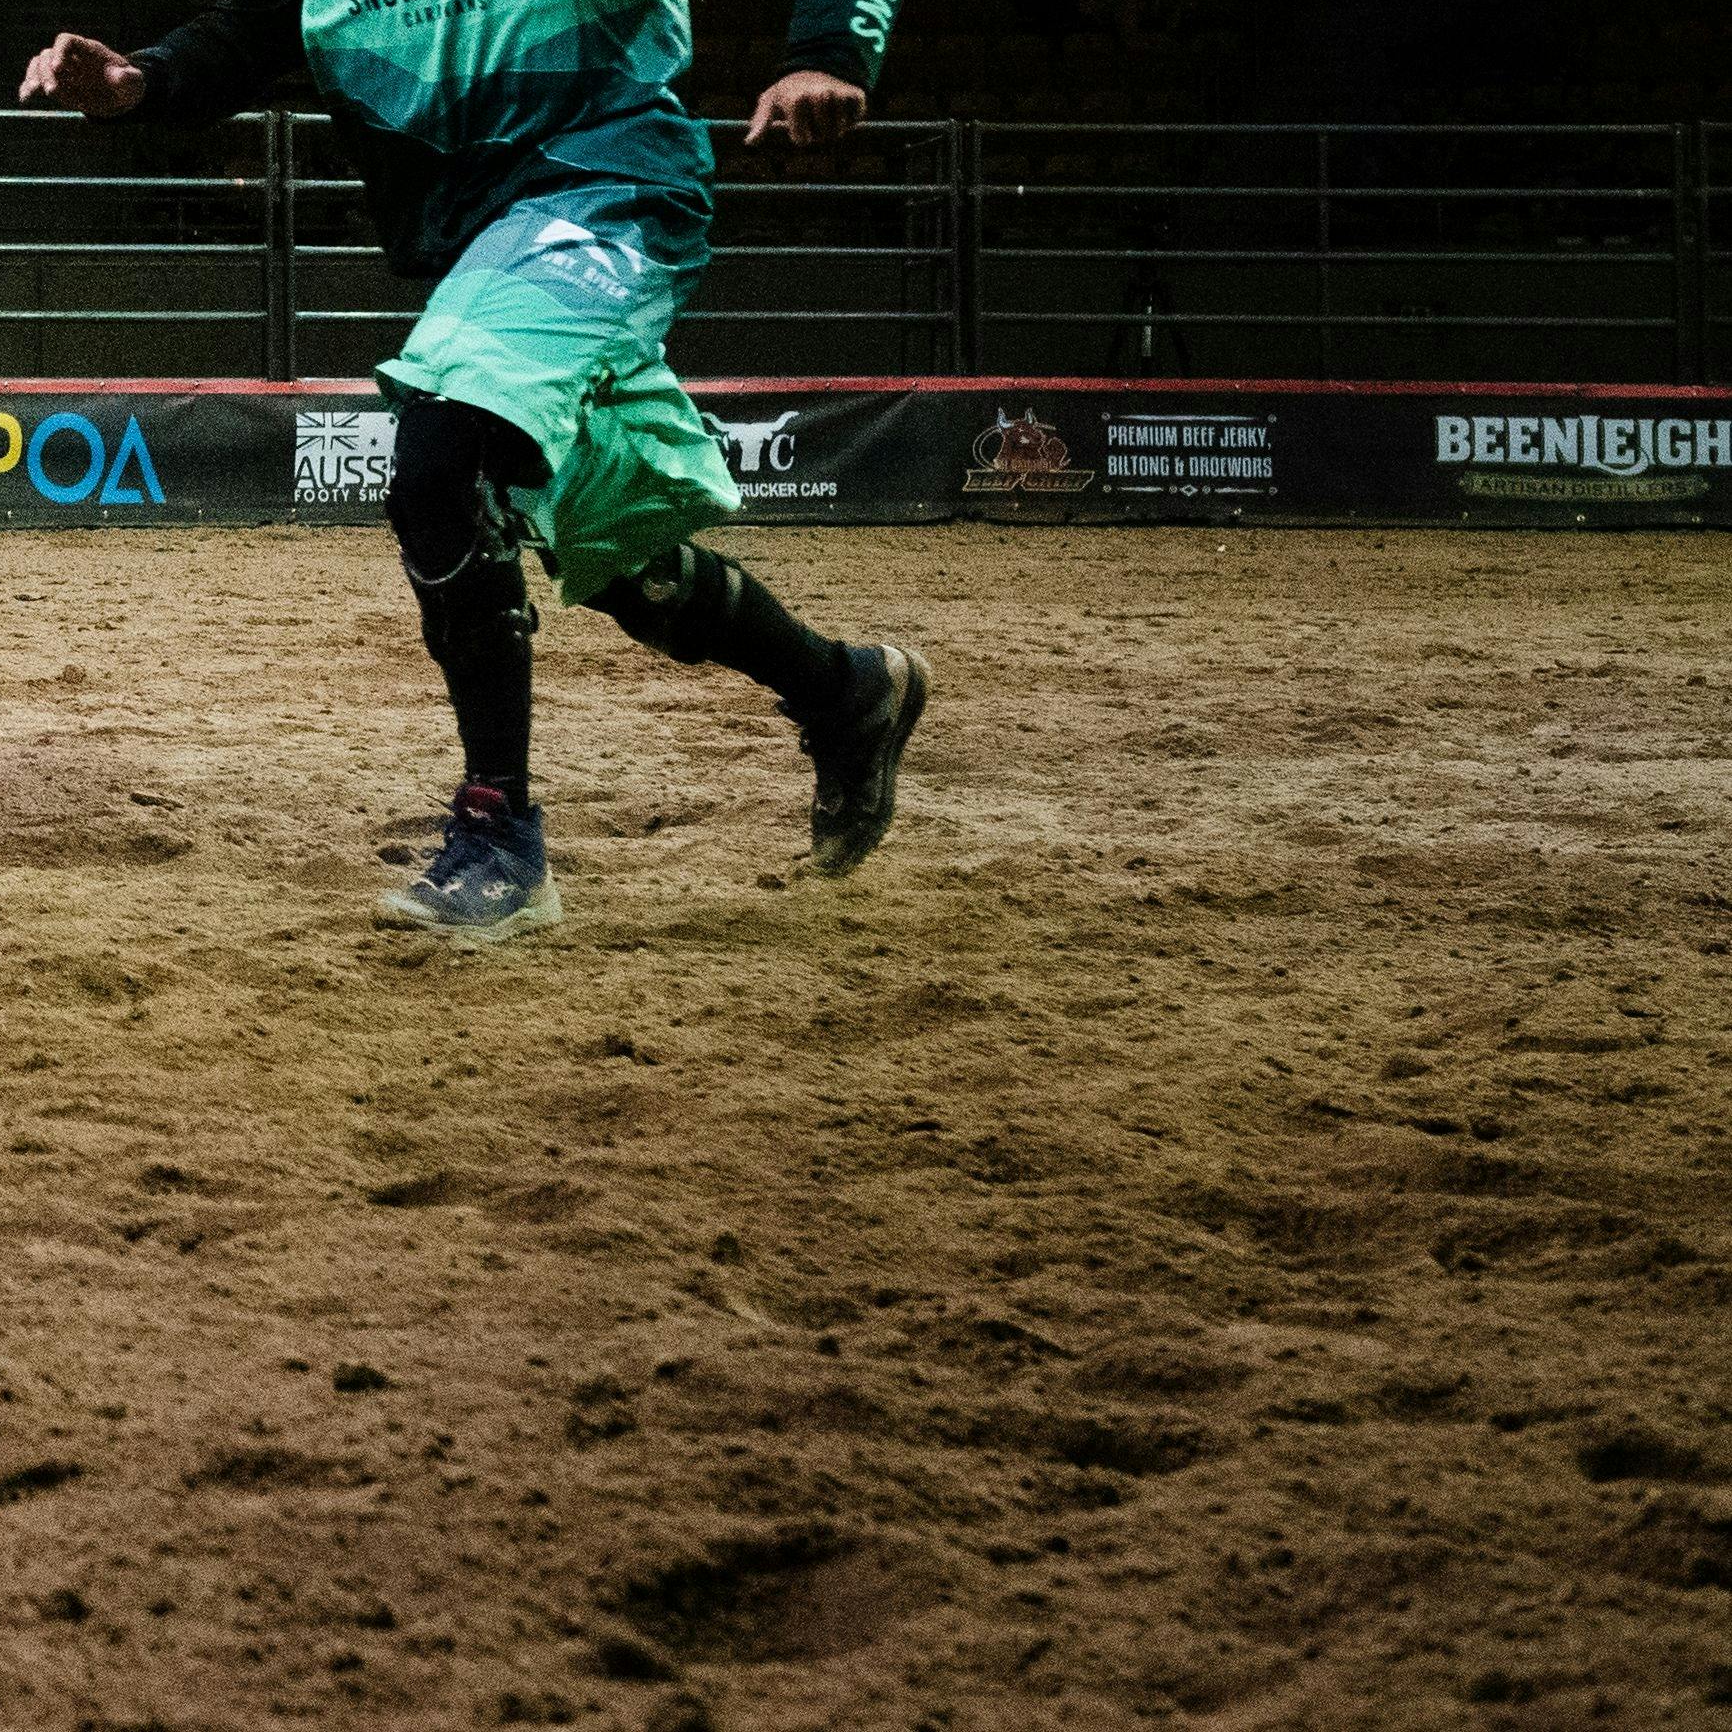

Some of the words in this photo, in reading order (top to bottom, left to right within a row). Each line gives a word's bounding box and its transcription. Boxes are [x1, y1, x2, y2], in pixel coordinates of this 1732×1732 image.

[1107, 424, 1179, 447] PREMIUM
[1182, 425, 1216, 448] BEEF
[1219, 425, 1273, 451] JERKY,
[1436, 414, 1732, 476] BEENLEIGH
[1107, 454, 1170, 477] BILTONG
[1174, 456, 1185, 477] &
[1188, 456, 1274, 479] DROEWORS
[294, 487, 350, 503] FOOTY
[800, 482, 838, 497] CAPS
[1480, 479, 1566, 496] ARTISAN
[1571, 480, 1688, 498] DISTILLERS
